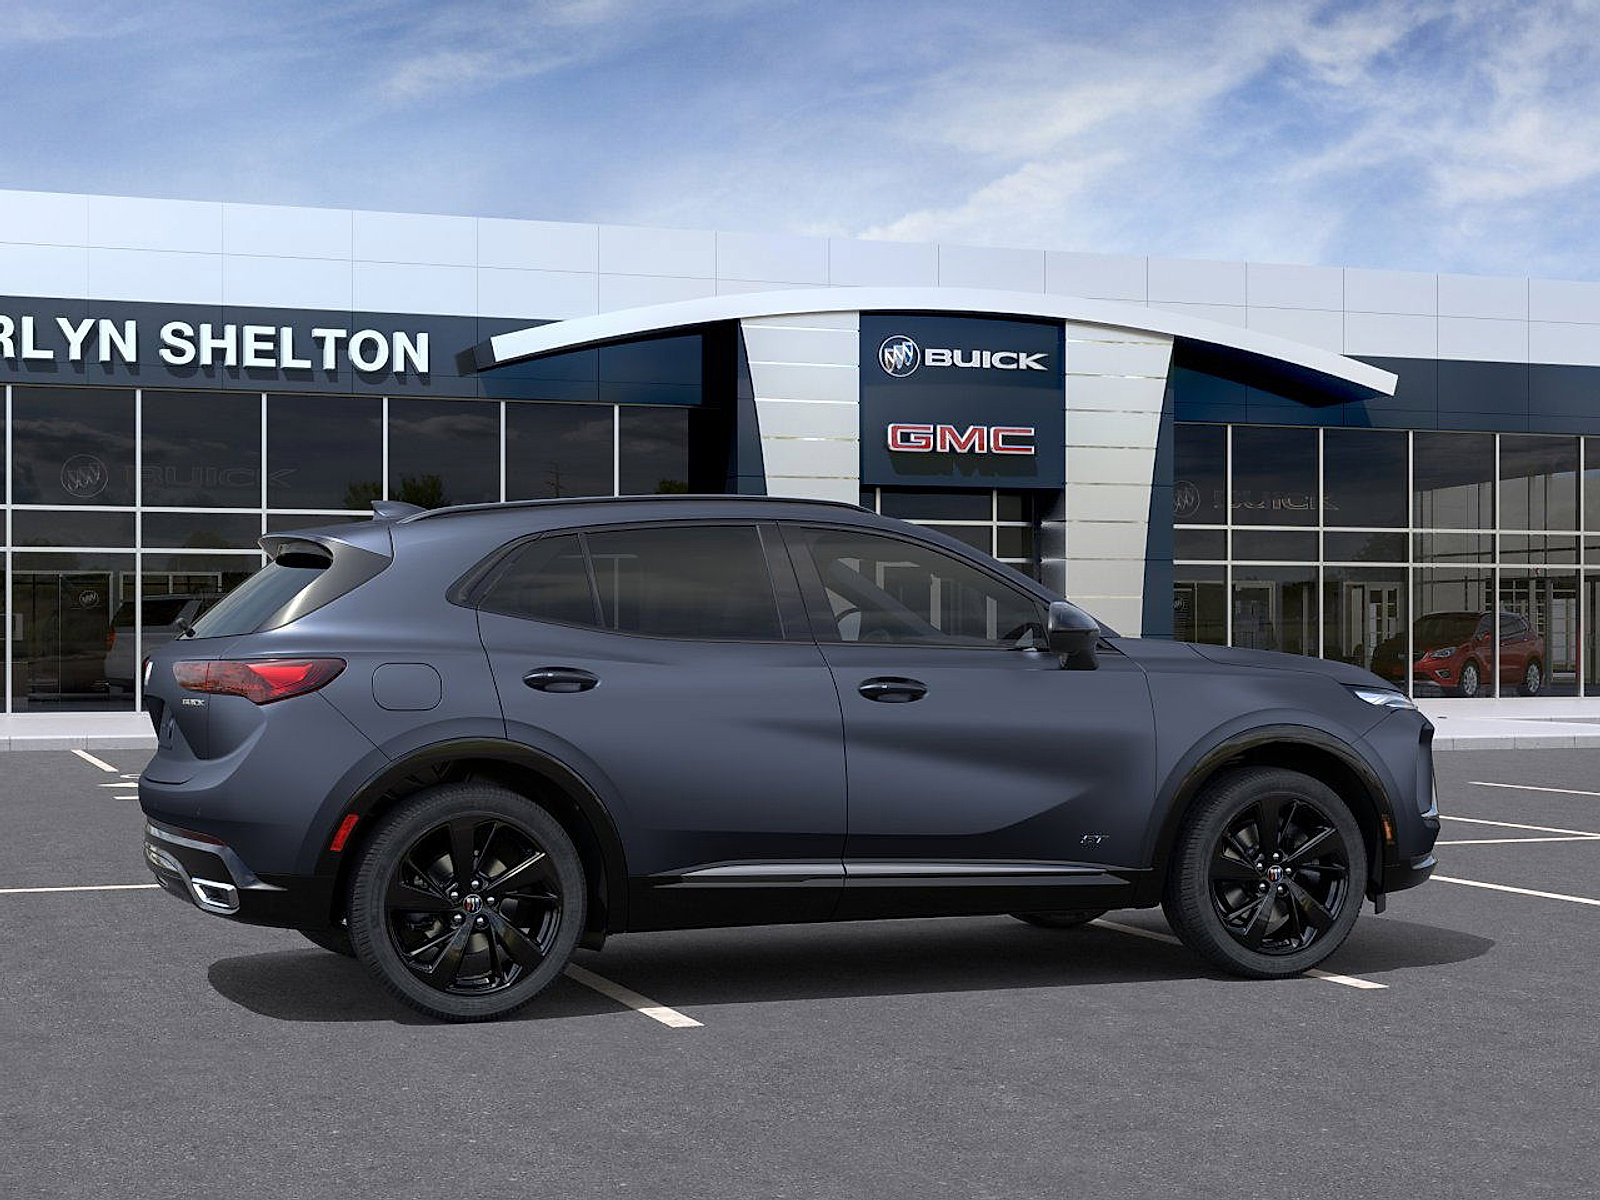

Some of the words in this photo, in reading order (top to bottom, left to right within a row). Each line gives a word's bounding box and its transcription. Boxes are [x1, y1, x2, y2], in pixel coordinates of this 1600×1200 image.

[158, 320, 430, 374] SHELTON
[924, 348, 1048, 371] BUICK
[887, 423, 1035, 455] GMC
